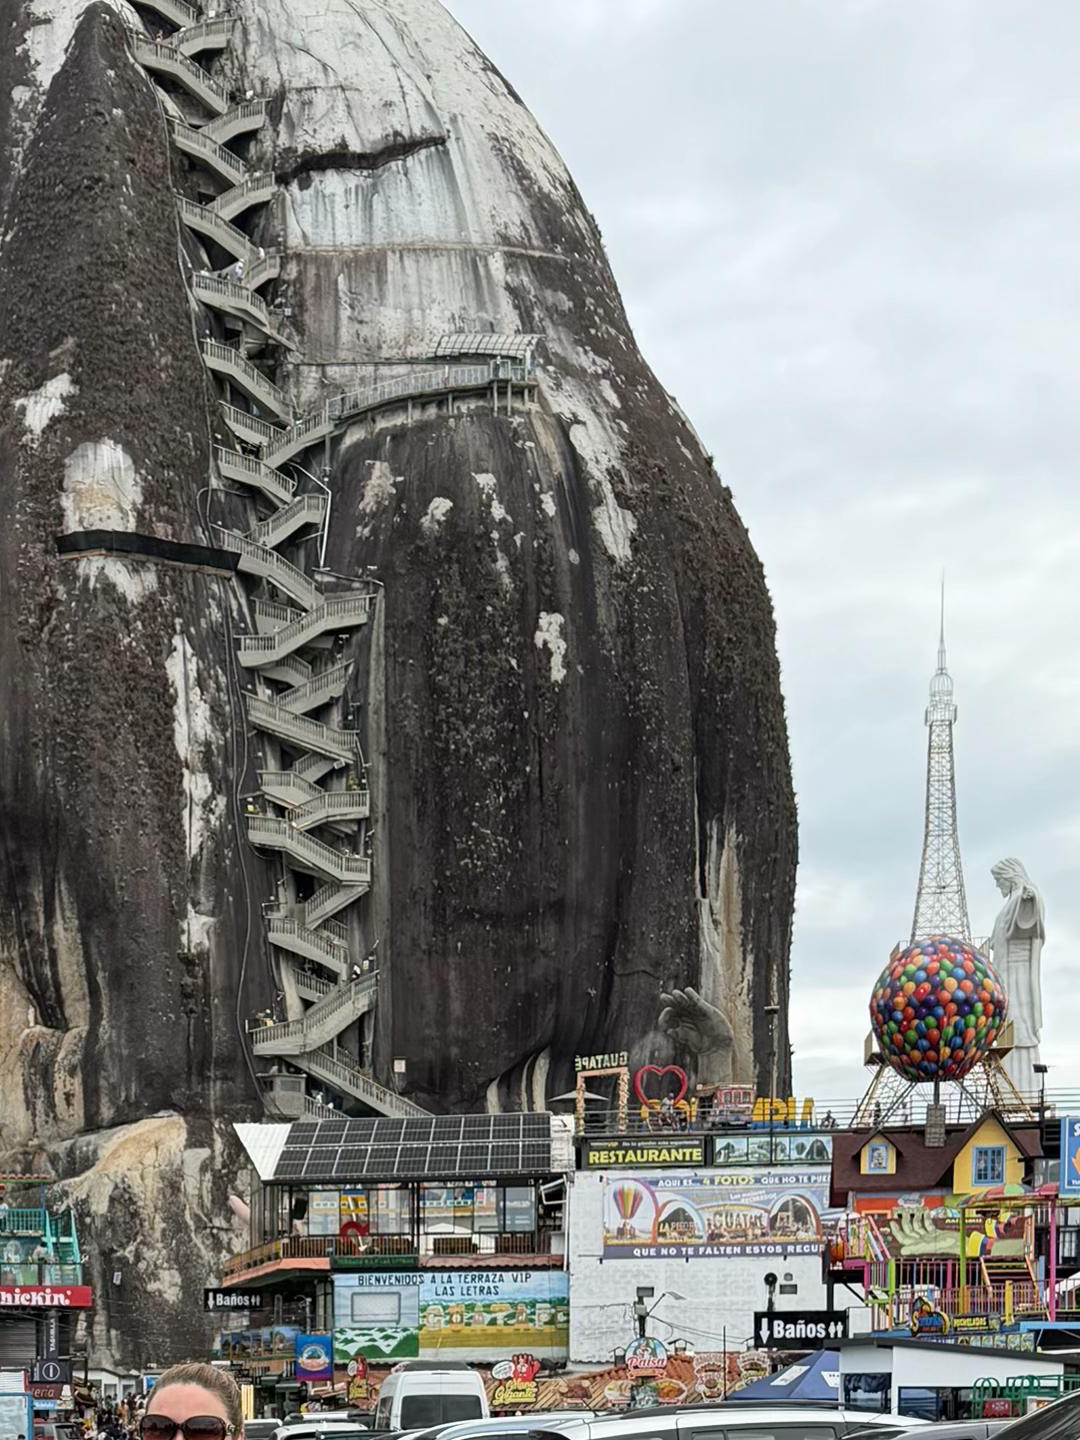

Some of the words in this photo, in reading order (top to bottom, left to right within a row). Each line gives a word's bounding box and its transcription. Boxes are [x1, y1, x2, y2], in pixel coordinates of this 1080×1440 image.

[589, 1148, 702, 1164] RESTAURANTE
[658, 1179, 681, 1188] AQUI
[702, 1177, 710, 1186] 4
[714, 1175, 754, 1186] FOTOS
[761, 1176, 780, 1185] QUE
[782, 1175, 797, 1184] NO
[798, 1175, 809, 1183] TE
[633, 1248, 657, 1257] QUE
[660, 1247, 677, 1256] NO
[681, 1247, 696, 1256] TE
[698, 1246, 743, 1255] FALTEN
[746, 1245, 783, 1254] ESTOS
[358, 1274, 425, 1286] BIENVENIDOS
[430, 1273, 438, 1285] A
[440, 1273, 453, 1284] LA
[458, 1272, 505, 1284] TERRAZA
[511, 1272, 532, 1283] VIP
[435, 1286, 455, 1297] LAS
[460, 1285, 500, 1297] LETRAS
[216, 1293, 250, 1306] Baños
[773, 1320, 826, 1339] Baños
